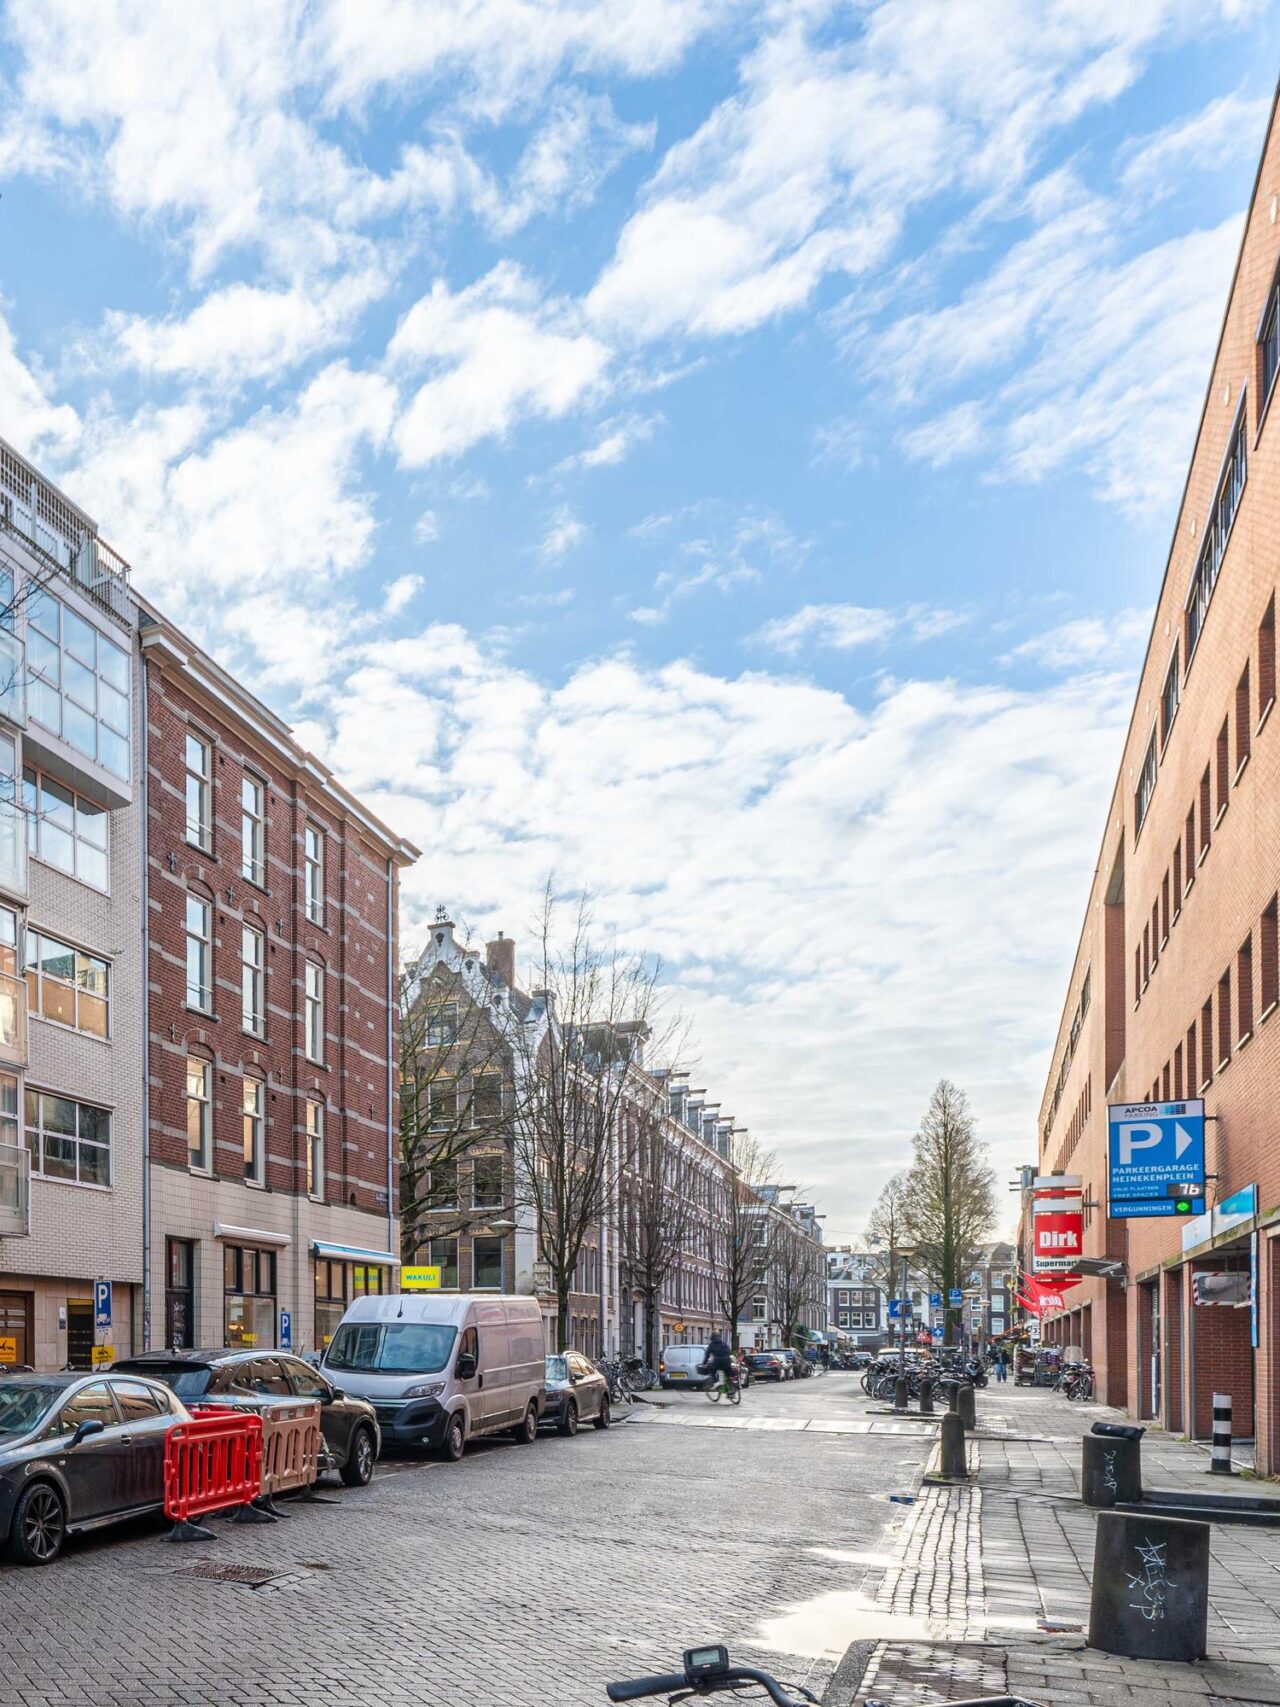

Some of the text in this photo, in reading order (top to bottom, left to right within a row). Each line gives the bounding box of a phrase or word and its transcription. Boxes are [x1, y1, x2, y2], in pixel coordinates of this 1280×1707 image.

[1124, 1106, 1158, 1114] APCOA
[1119, 1122, 1163, 1165] P
[1112, 1163, 1200, 1175] PARKEERGARAGE
[1112, 1172, 1195, 1183] HEINEKENPLEIN
[1179, 1183, 1200, 1195] 76
[1114, 1205, 1173, 1213] VERGUNNINGEN
[1039, 1231, 1078, 1248] Dirk
[98, 1284, 108, 1309] P
[282, 1315, 289, 1334] P
